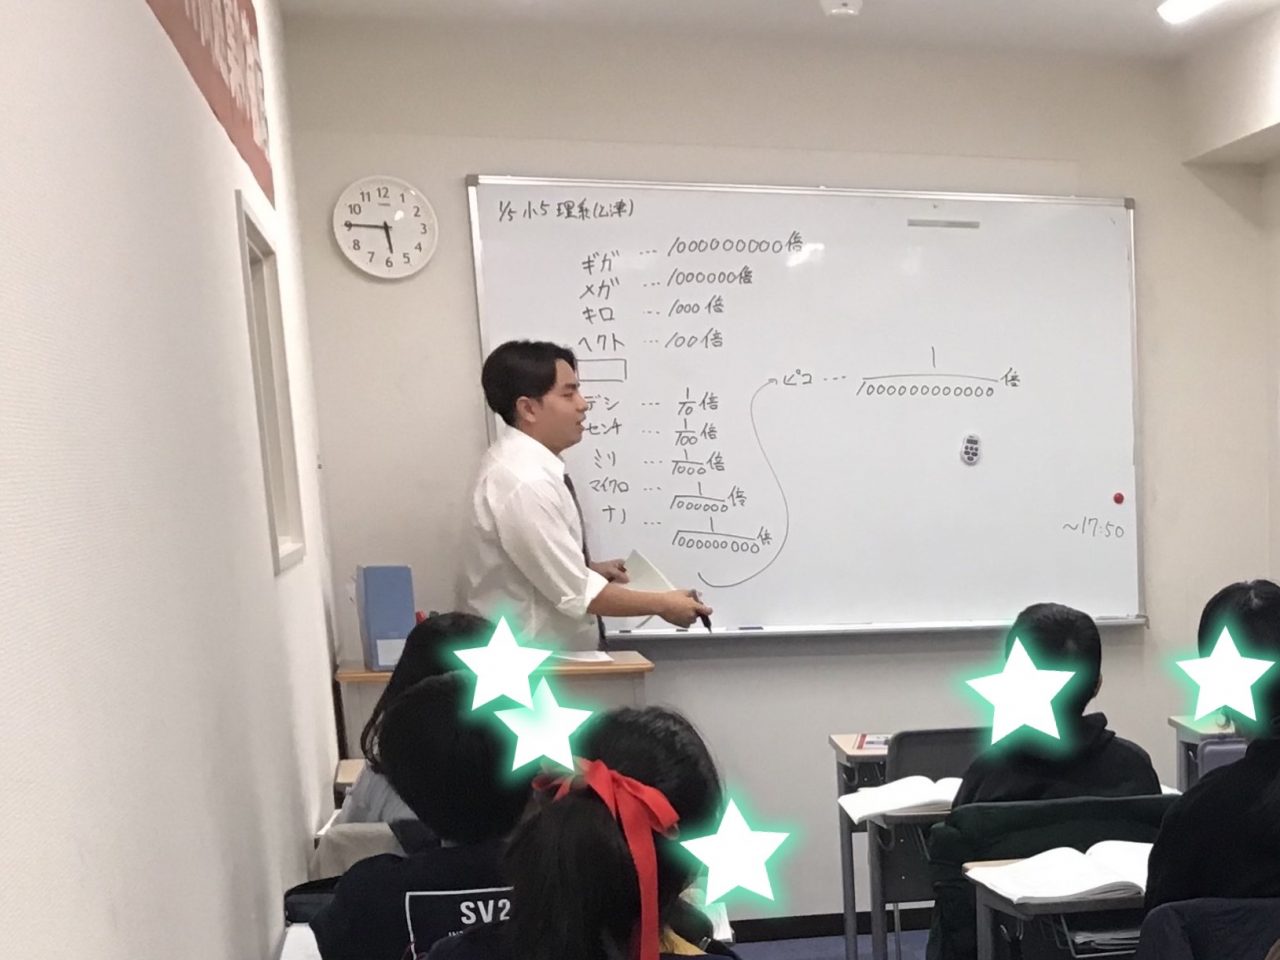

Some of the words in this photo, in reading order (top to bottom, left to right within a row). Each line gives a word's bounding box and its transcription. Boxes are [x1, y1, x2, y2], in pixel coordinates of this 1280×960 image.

[359, 191, 371, 202] 11
[376, 186, 390, 199] 12
[400, 192, 405, 203] 1
[348, 203, 362, 216] 10
[413, 205, 421, 218] 2
[499, 200, 517, 222] 1/5
[523, 199, 550, 219] 小5
[343, 220, 353, 232] 9
[420, 222, 428, 235] 3
[352, 238, 361, 251] 8
[414, 241, 422, 253] 4
[367, 251, 375, 263] 7
[385, 256, 394, 268] 6
[402, 252, 411, 265] 5
[581, 249, 620, 276] ギガ
[578, 275, 620, 301] メガ
[582, 306, 616, 324] キロ
[578, 333, 625, 352] ヘクト
[783, 368, 813, 386] ピコ
[1000, 367, 1021, 387] 倍
[584, 393, 619, 411] デシ
[698, 391, 719, 411] 倍
[586, 417, 622, 435] センチ
[699, 421, 718, 440] 倍
[593, 448, 616, 470] ミリ
[706, 450, 726, 472] 倍
[588, 476, 630, 494] マイクロ
[727, 485, 748, 507] 倍
[602, 504, 627, 524] ナノ
[757, 526, 773, 546] 倍
